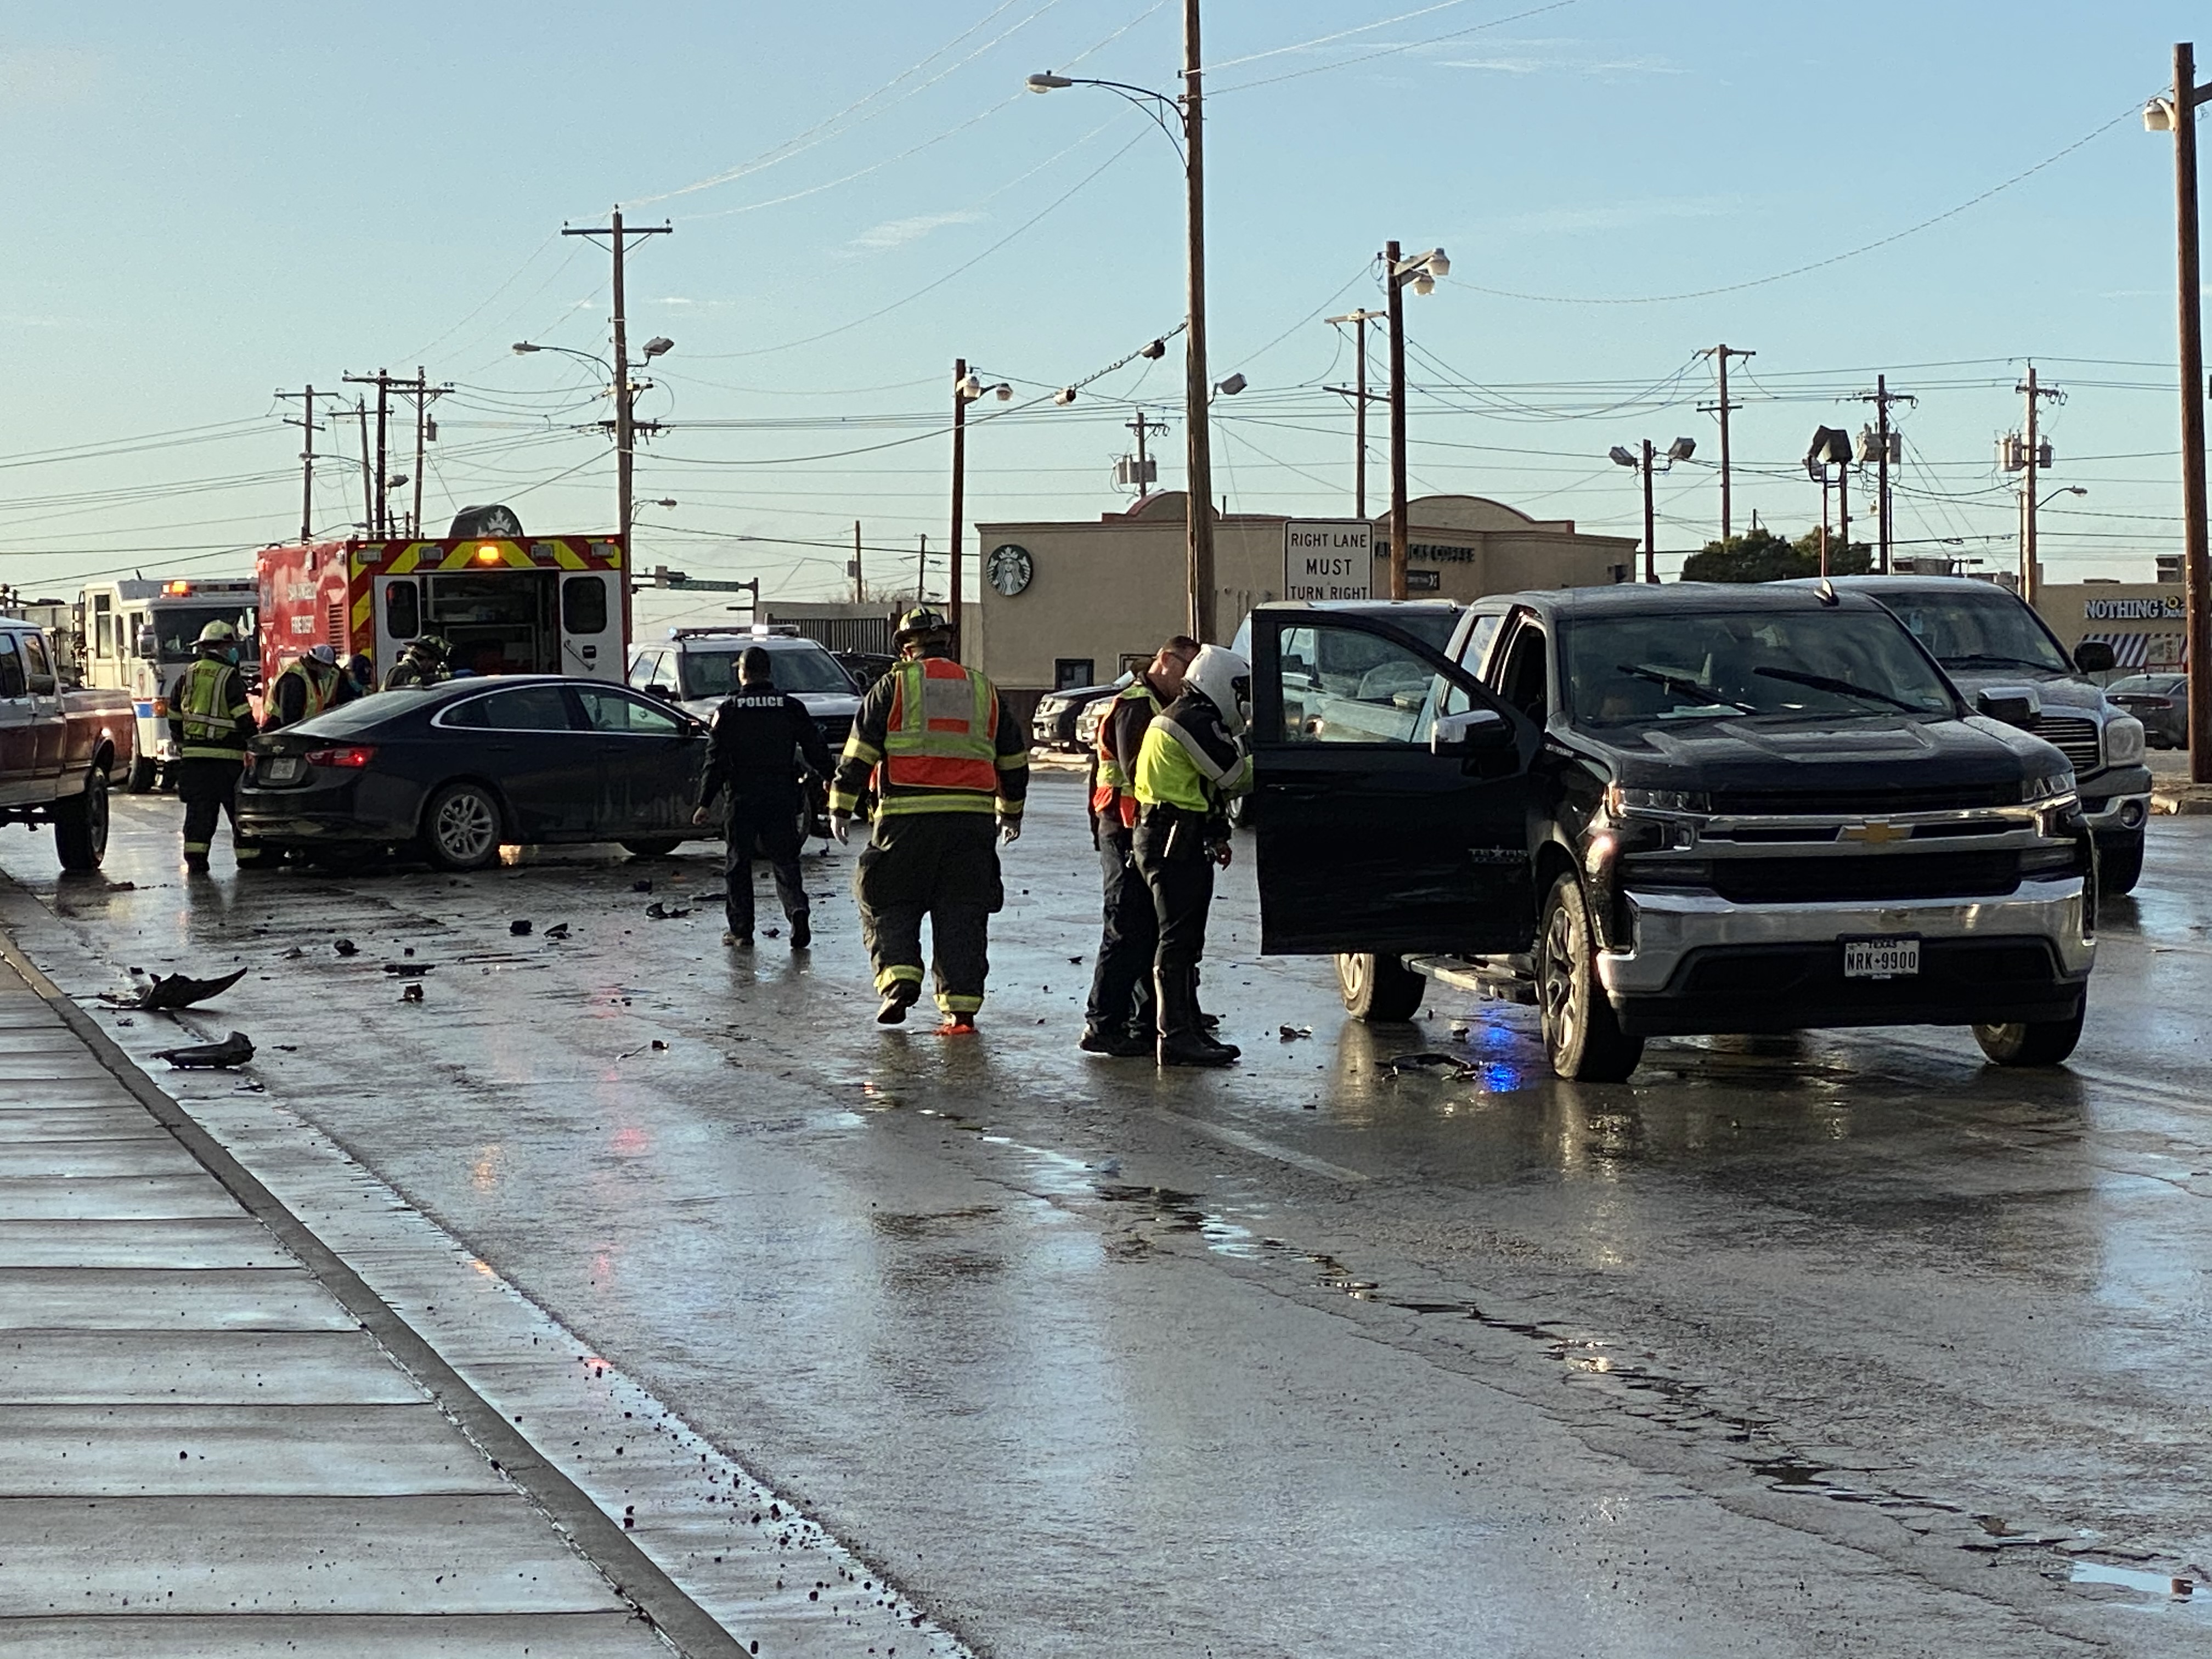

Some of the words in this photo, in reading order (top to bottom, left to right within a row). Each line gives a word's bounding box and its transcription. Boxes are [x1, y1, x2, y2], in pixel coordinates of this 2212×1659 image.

[1291, 533, 1328, 548] RIGHT
[1334, 534, 1367, 548] LANE
[1306, 558, 1352, 575] MUST
[1290, 586, 1323, 600] TURN
[1330, 586, 1367, 600] RIGHT
[2084, 599, 2159, 619] NOTHING
[157, 679, 167, 696] 7
[737, 696, 784, 708] POLICE
